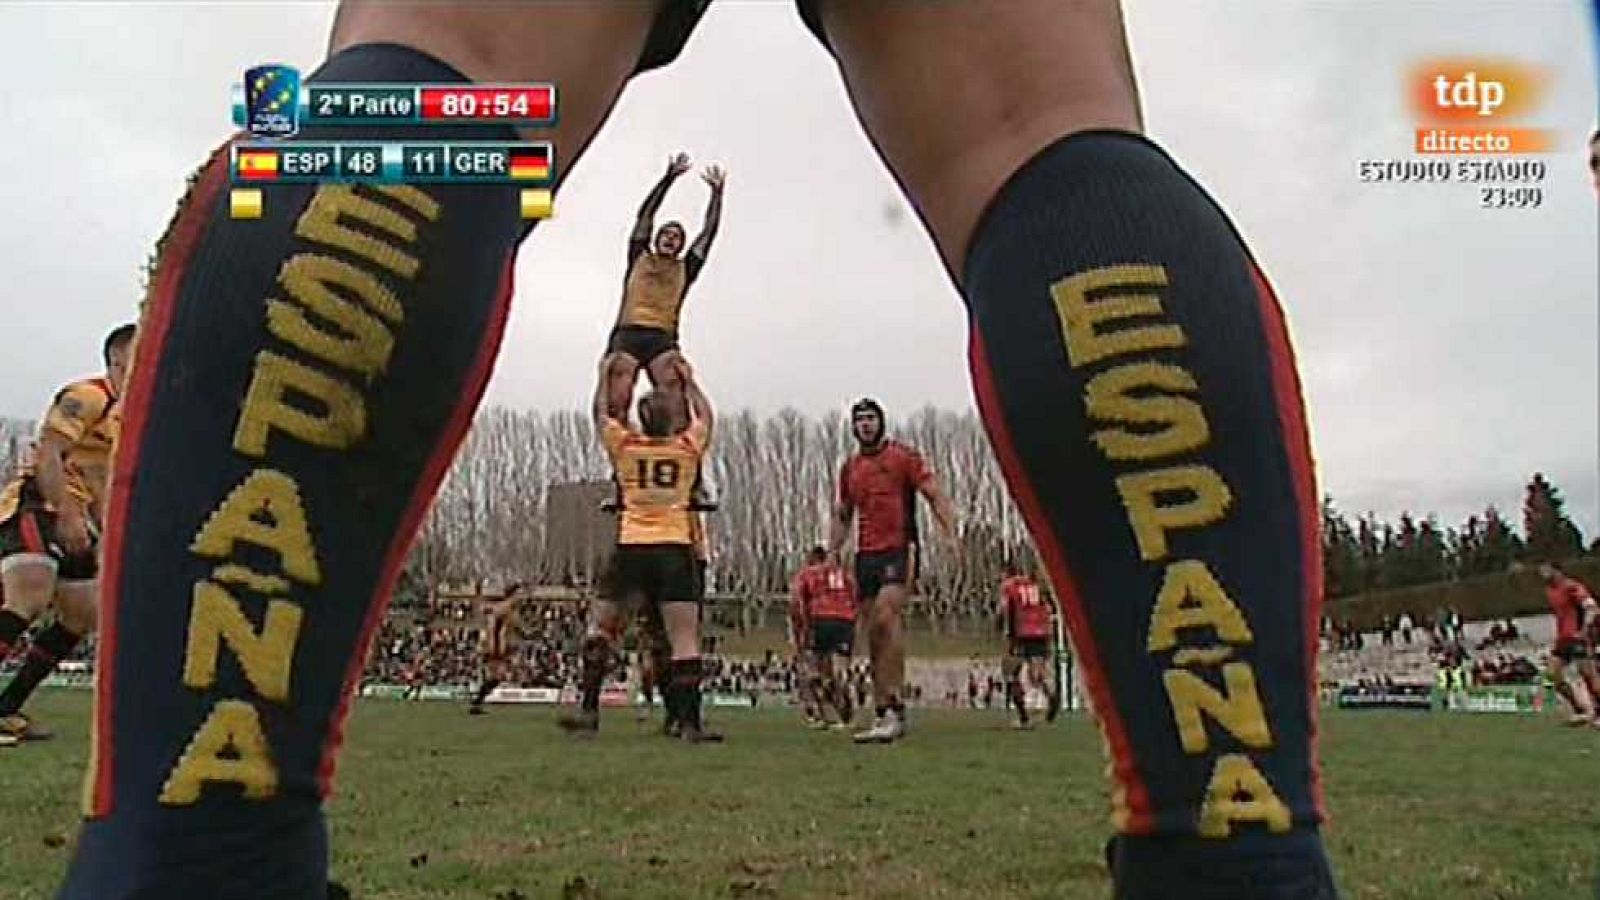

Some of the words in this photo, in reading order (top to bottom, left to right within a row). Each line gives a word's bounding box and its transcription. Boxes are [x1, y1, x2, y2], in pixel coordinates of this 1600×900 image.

[160, 183, 440, 804] ESPAÑA
[636, 458, 680, 489] 18
[1050, 263, 1292, 838] ESPAÑA
